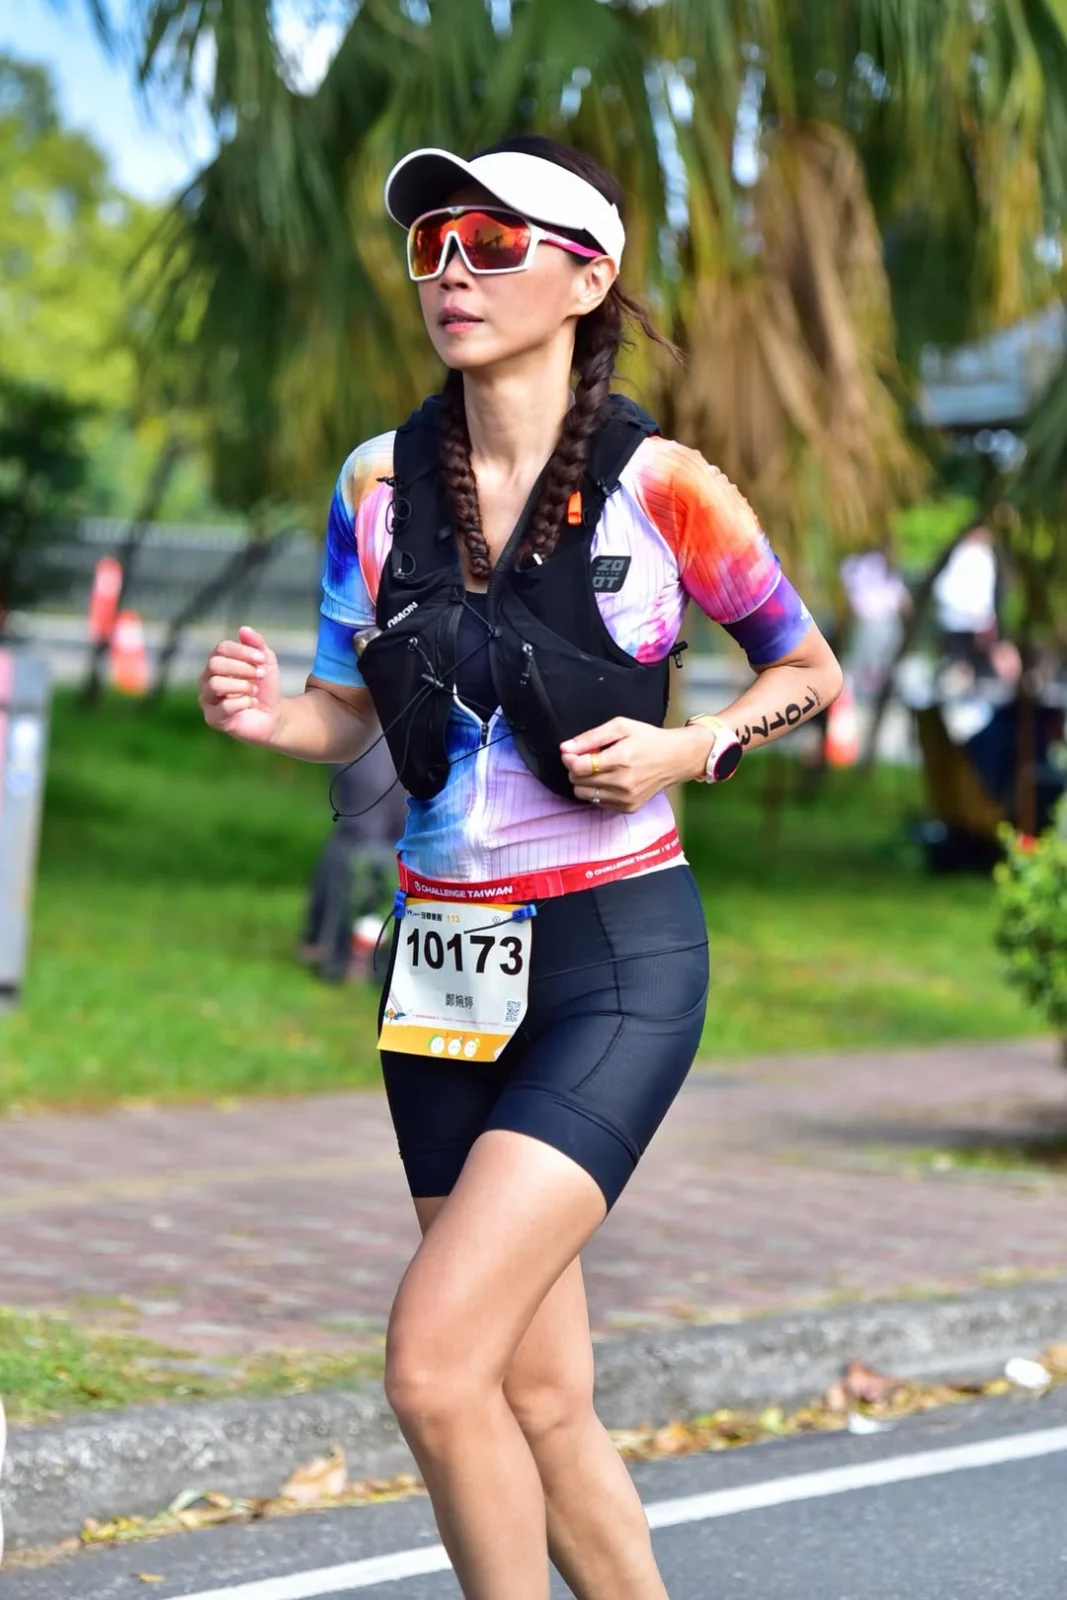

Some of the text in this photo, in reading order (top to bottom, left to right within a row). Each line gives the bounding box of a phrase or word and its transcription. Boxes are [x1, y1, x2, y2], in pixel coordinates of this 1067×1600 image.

[735, 696, 815, 746] 10173
[421, 885, 513, 898] CHALLENGE TAIWAN
[406, 928, 524, 976] 10173
